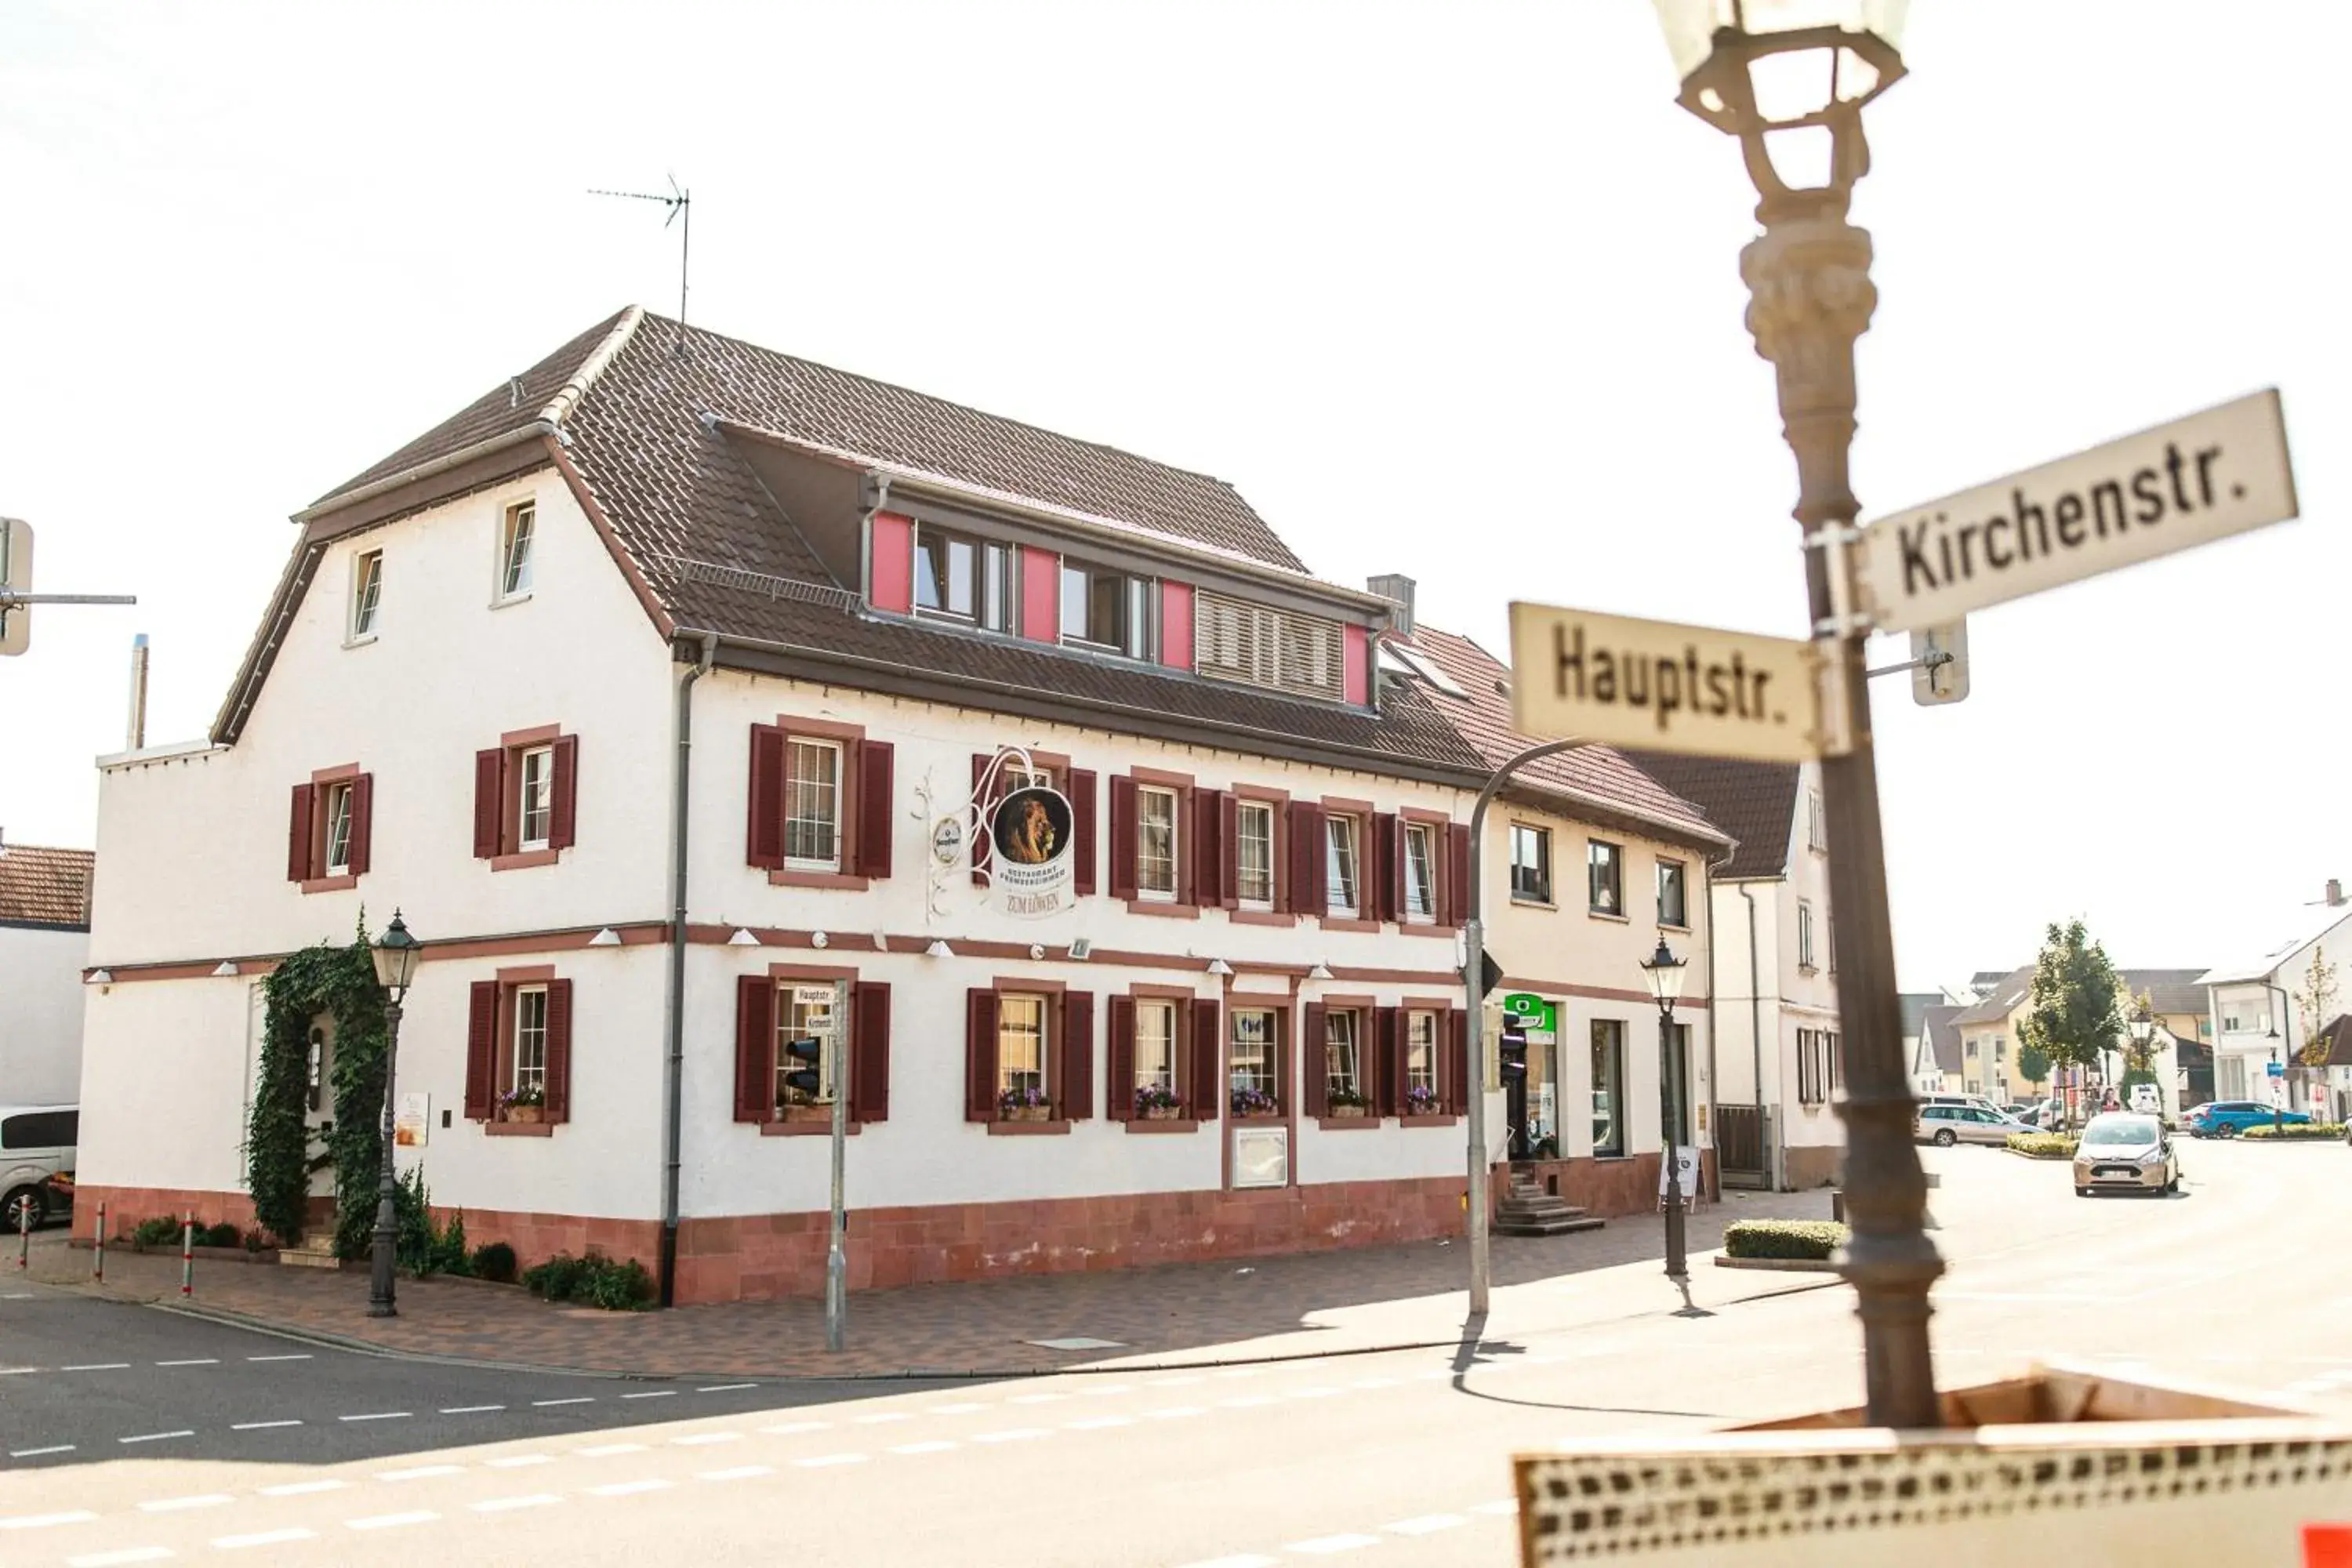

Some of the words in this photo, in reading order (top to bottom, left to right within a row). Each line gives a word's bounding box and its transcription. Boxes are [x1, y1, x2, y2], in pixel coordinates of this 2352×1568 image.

[1897, 442, 2247, 595] Kirchenstr.
[1552, 621, 1788, 731] Hauptstr.
[1007, 865, 1057, 878] RESTAURANT
[1007, 894, 1027, 915] ZUM
